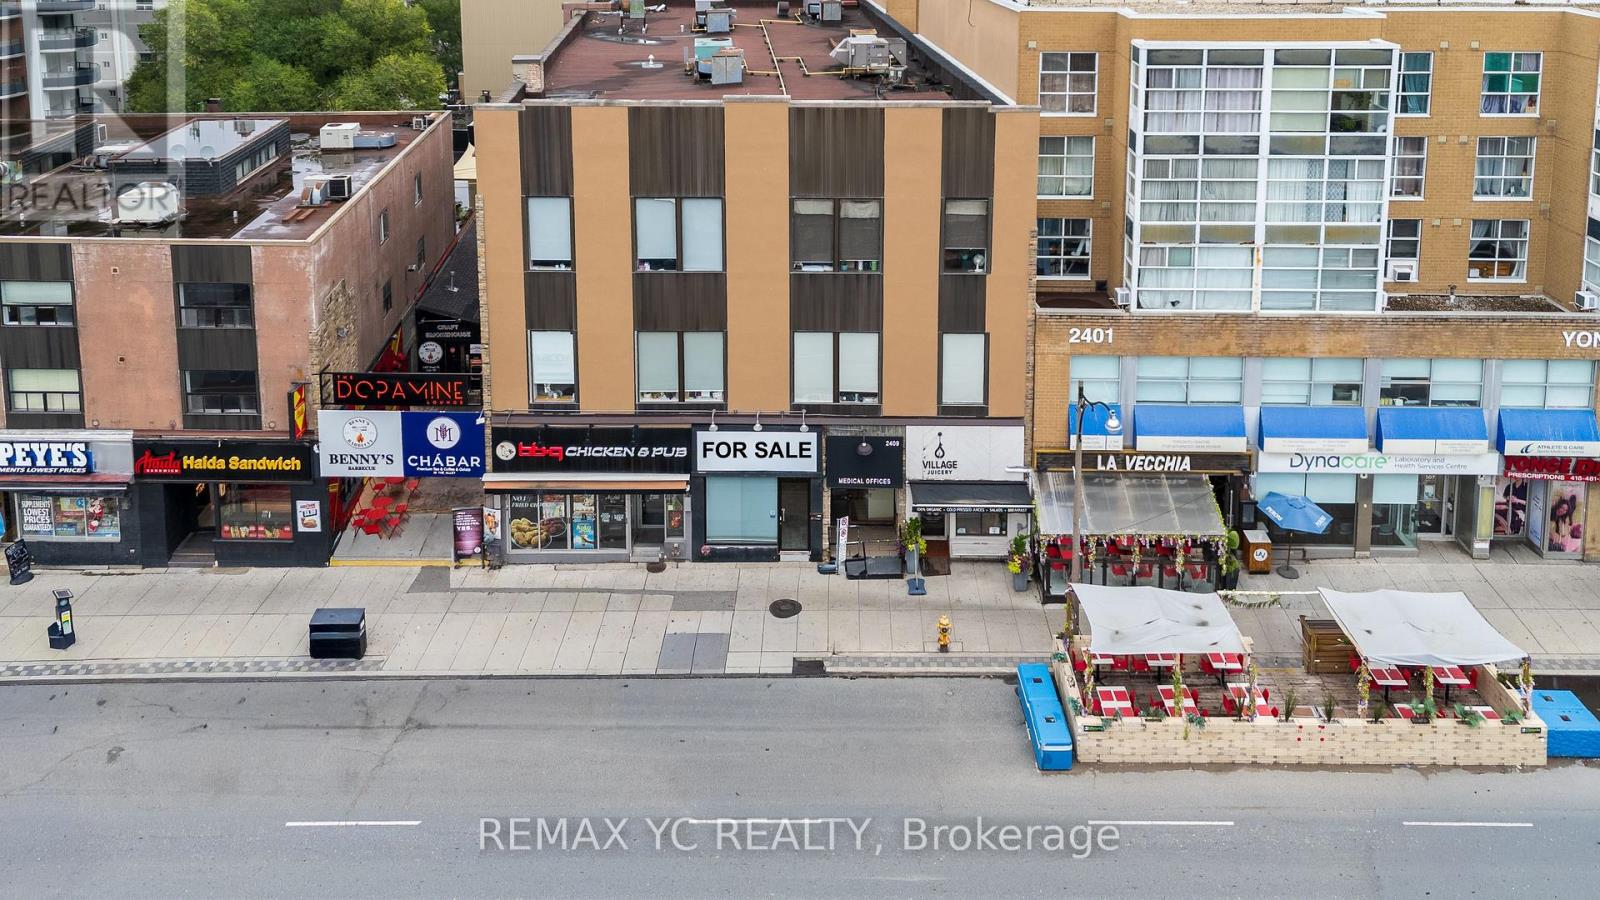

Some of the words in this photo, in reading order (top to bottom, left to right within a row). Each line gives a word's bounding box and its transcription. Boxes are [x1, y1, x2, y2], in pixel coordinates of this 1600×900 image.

[1069, 328, 1114, 344] 2401
[337, 380, 463, 400] DOPAMINE
[565, 447, 636, 457] CHICKEN
[637, 447, 650, 458] &
[651, 447, 687, 458] PUB
[703, 442, 748, 459] FOR
[754, 442, 812, 459] SALE
[183, 455, 225, 470] Haida
[229, 456, 301, 471] Sandwich
[328, 453, 394, 465] BENNY'S
[922, 461, 957, 469] VILLAGE
[1097, 455, 1118, 471] LA
[1125, 455, 1191, 471] VECCHIA
[1289, 453, 1388, 471] Dynacare
[1507, 472, 1565, 480] PRESCRIPTIONS
[23, 508, 49, 516] LOWEST
[24, 516, 50, 524] PRICES
